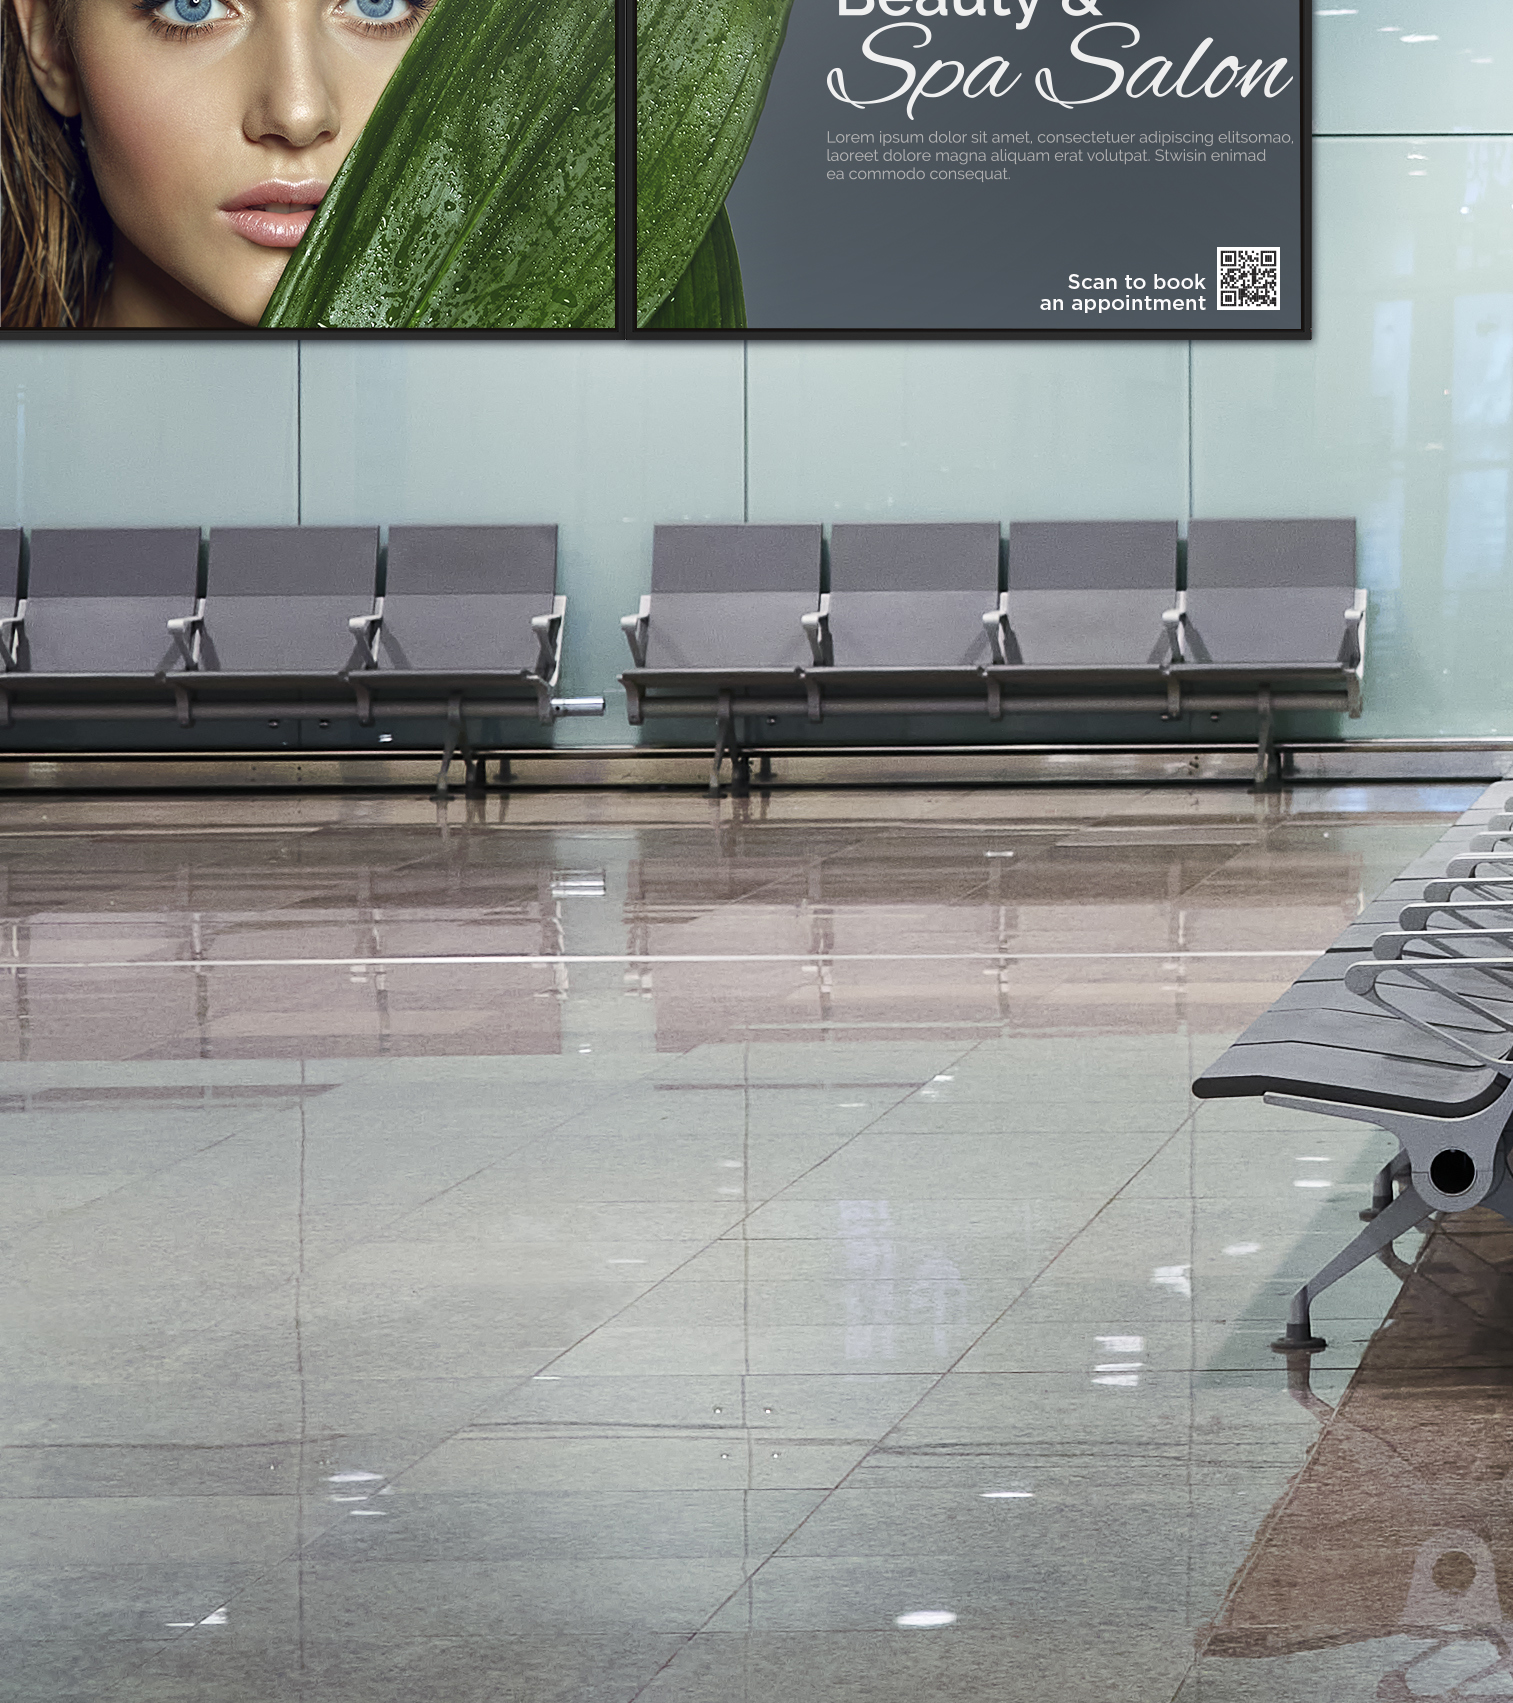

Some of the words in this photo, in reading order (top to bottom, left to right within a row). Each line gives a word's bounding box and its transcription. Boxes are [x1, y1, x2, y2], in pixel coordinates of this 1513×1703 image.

[827, 22, 1022, 120] Spa
[1035, 22, 1293, 109] Salon
[827, 130, 875, 144] Lorem
[879, 130, 924, 148] ipsum
[928, 130, 968, 144] dolor
[970, 130, 988, 144] sit
[991, 130, 1033, 145] amet,
[1037, 130, 1136, 144] consectetuer
[1139, 130, 1214, 148] adipiscing
[1217, 130, 1294, 145] elitsomao,
[826, 148, 880, 162] laoreet
[882, 148, 932, 162] dolore
[935, 151, 987, 166] magna
[990, 148, 1050, 166] aliquam
[1054, 149, 1084, 162] erat
[1086, 148, 1151, 166] volutpat.
[1154, 148, 1207, 162] Stwisin
[1210, 148, 1267, 162] enimad
[826, 169, 845, 181] ea
[848, 166, 926, 180] commodo
[929, 167, 1011, 184] consequat.
[1067, 273, 1118, 290] Scan
[1124, 274, 1147, 290] to
[1153, 272, 1207, 290] book
[1039, 298, 1064, 311] an
[1071, 294, 1207, 314] appointment
